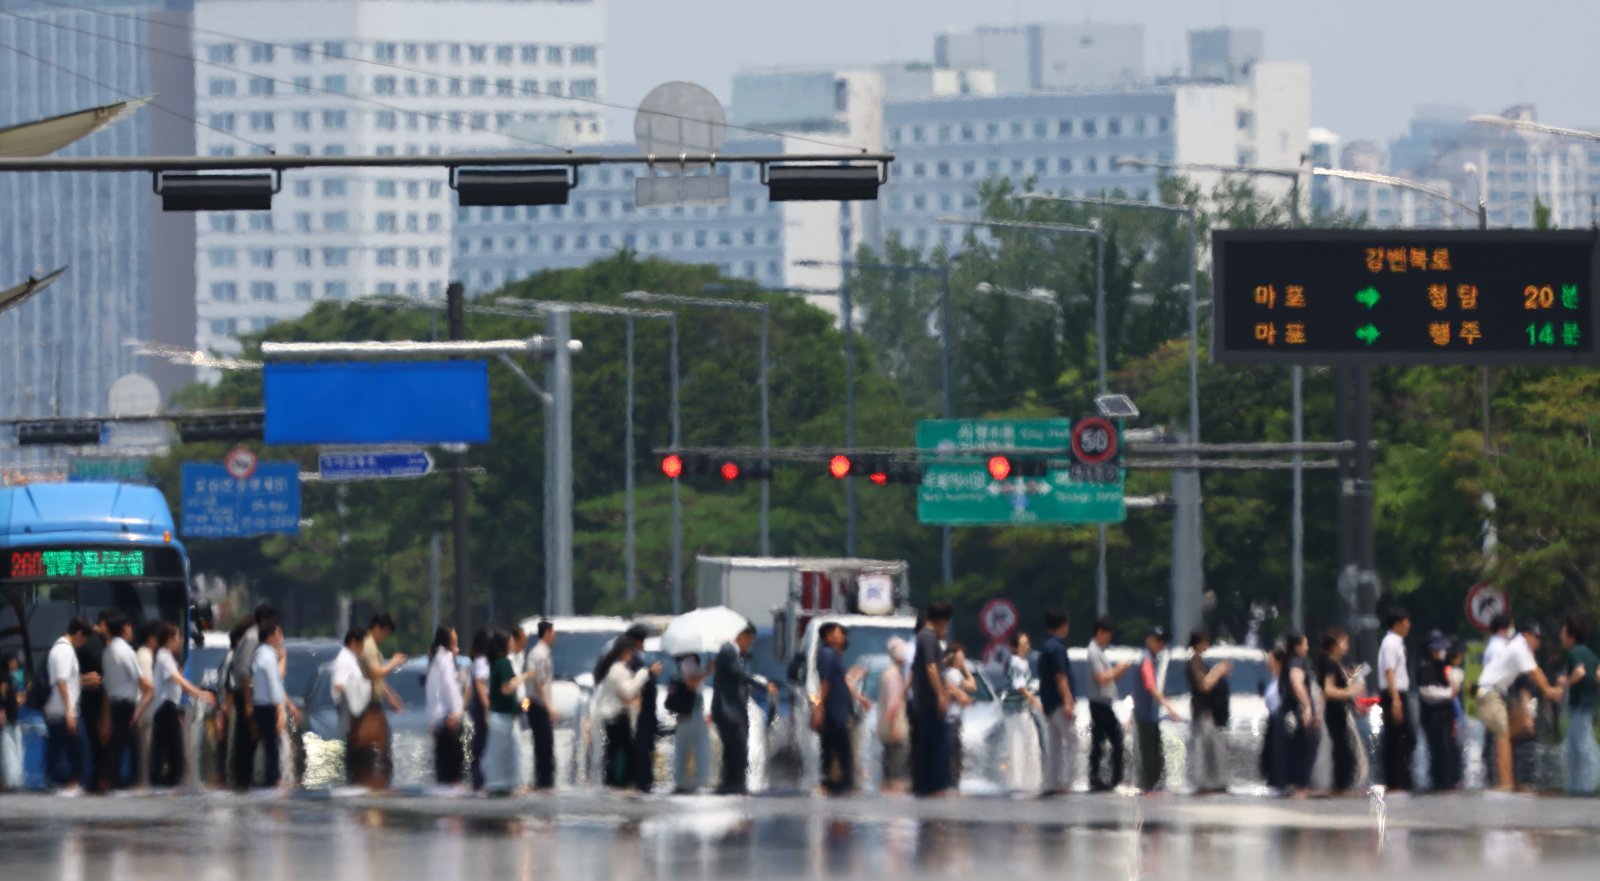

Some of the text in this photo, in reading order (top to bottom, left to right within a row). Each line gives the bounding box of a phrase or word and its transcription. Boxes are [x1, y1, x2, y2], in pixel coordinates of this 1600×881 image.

[1364, 247, 1452, 272] 강변북로
[1080, 428, 1109, 453] 50
[11, 551, 42, 577] 260
